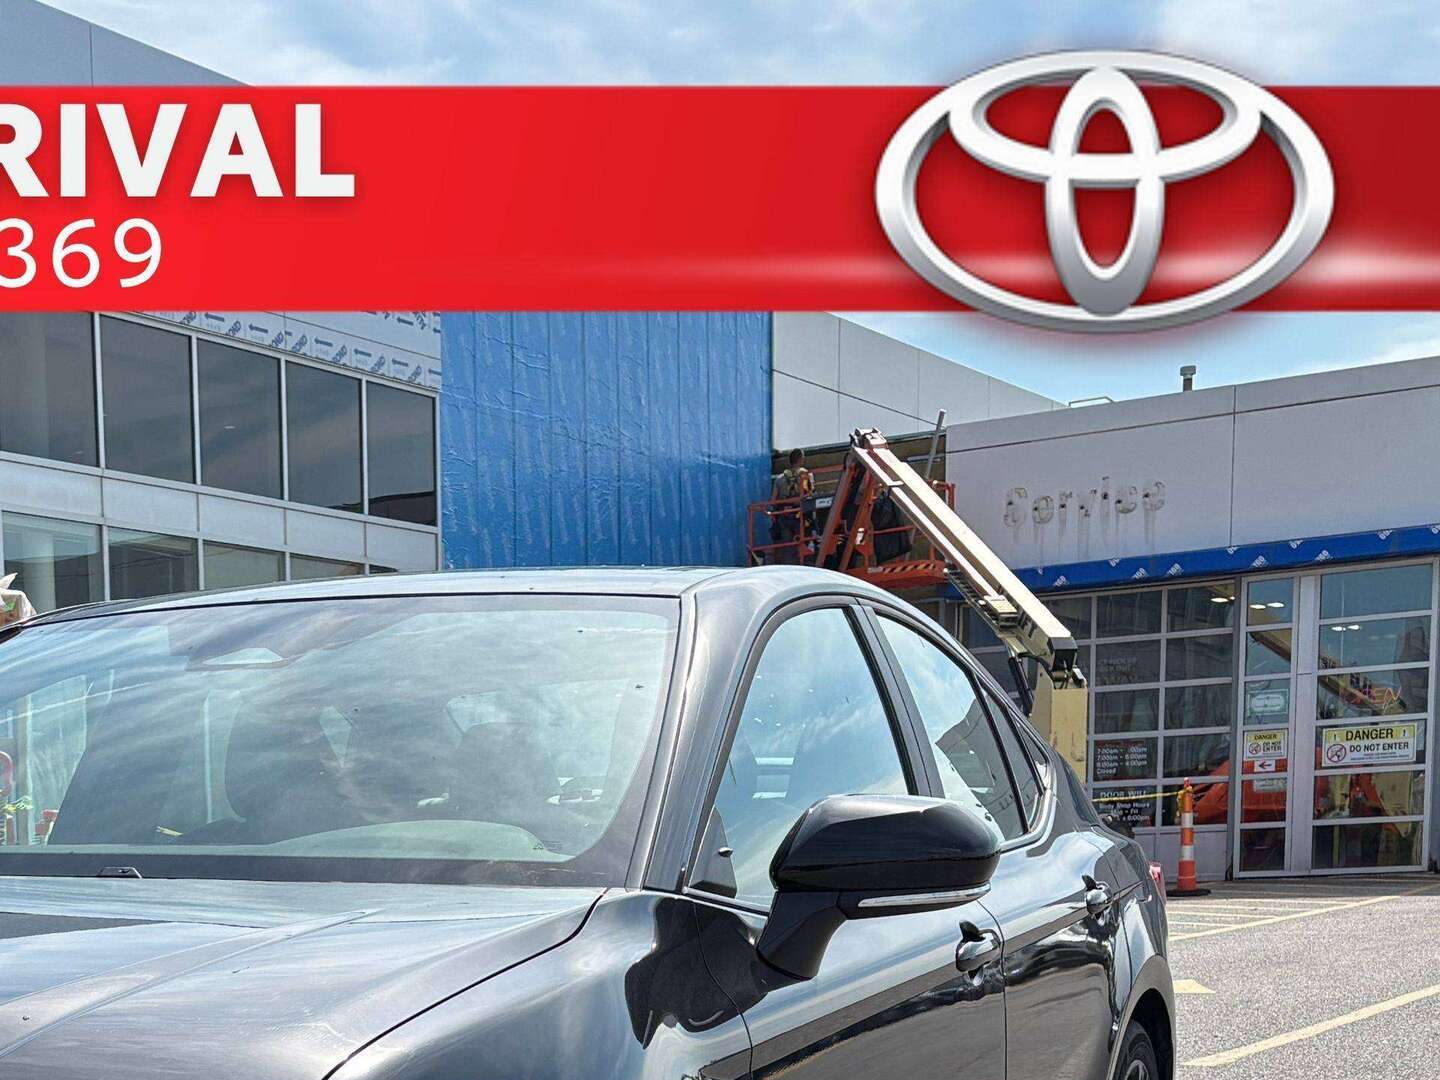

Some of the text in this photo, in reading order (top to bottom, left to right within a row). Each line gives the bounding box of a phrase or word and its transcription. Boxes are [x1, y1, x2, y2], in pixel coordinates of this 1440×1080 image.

[1254, 733, 1278, 741] DANGER
[1345, 728, 1394, 742] DANGER
[1349, 742, 1409, 753] DO NOT ENTER
